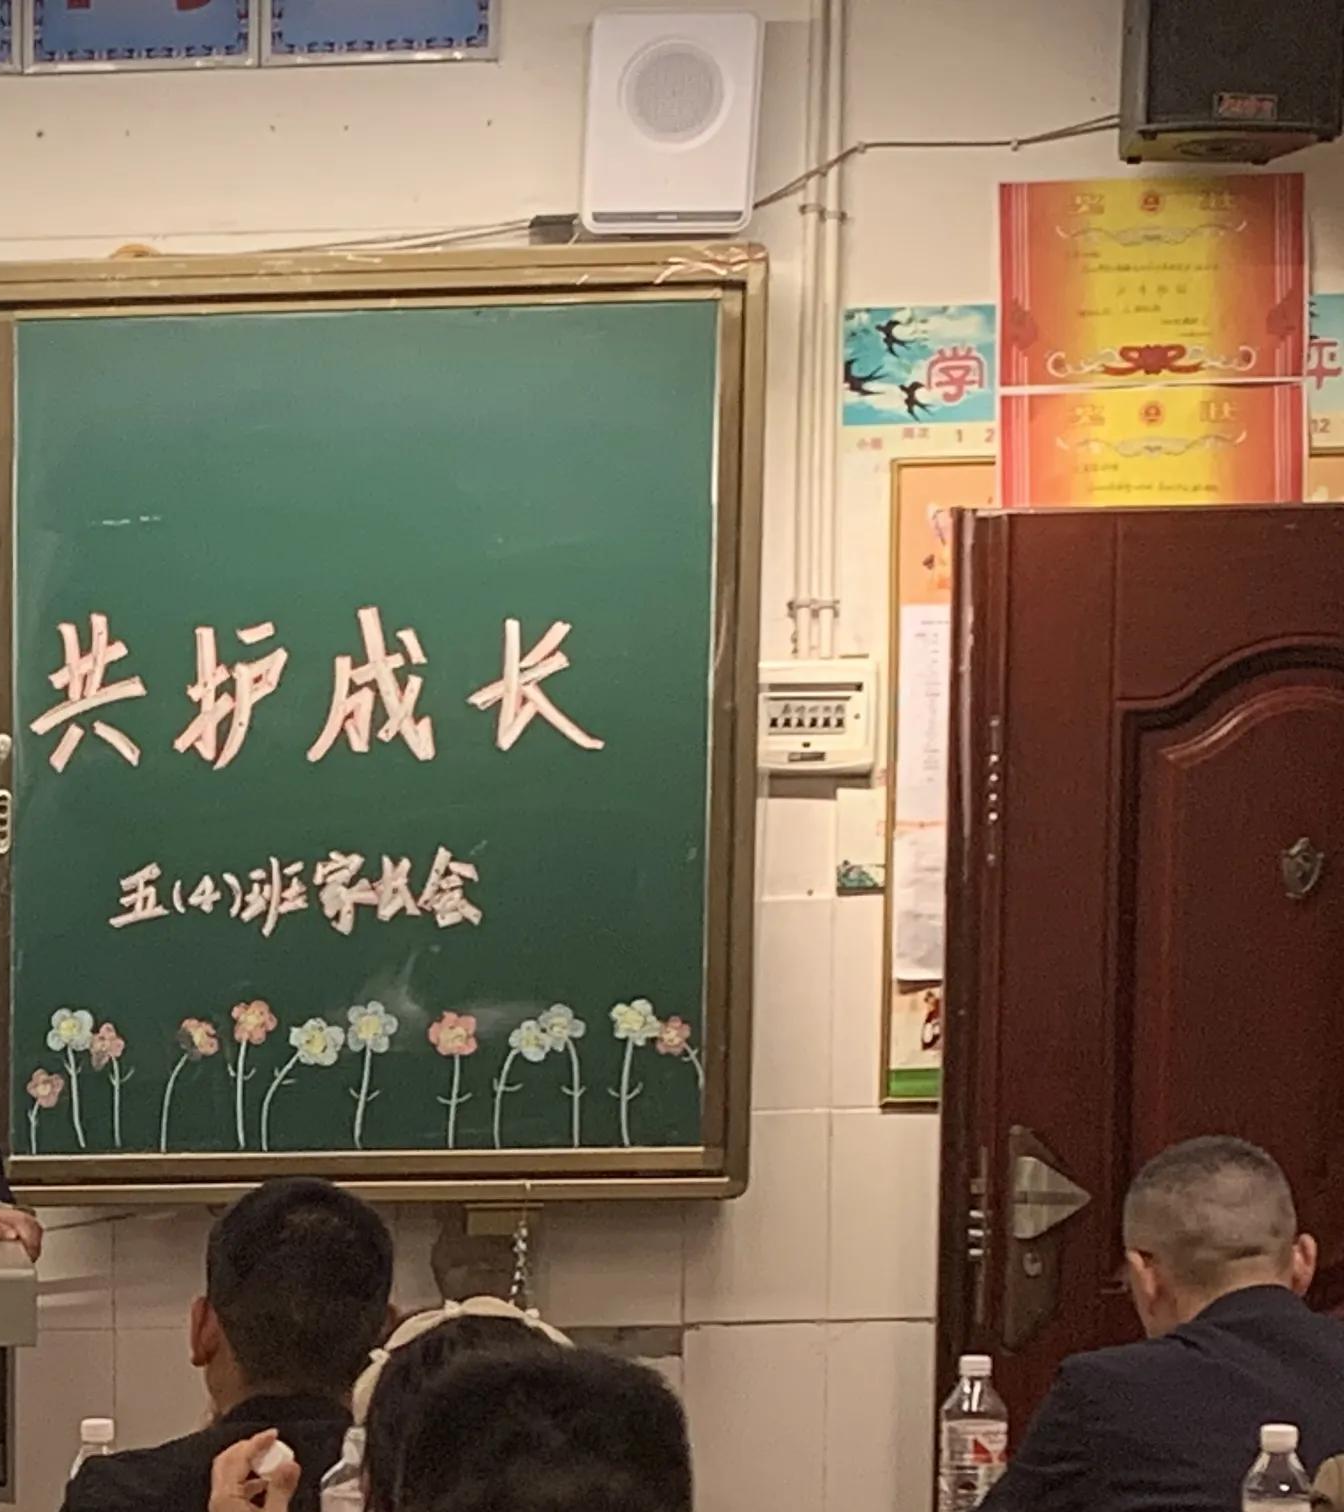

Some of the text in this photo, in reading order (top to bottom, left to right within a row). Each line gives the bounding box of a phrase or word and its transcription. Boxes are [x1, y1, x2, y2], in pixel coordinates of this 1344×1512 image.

[926, 346, 986, 402] 学
[29, 606, 604, 773] 共护成长
